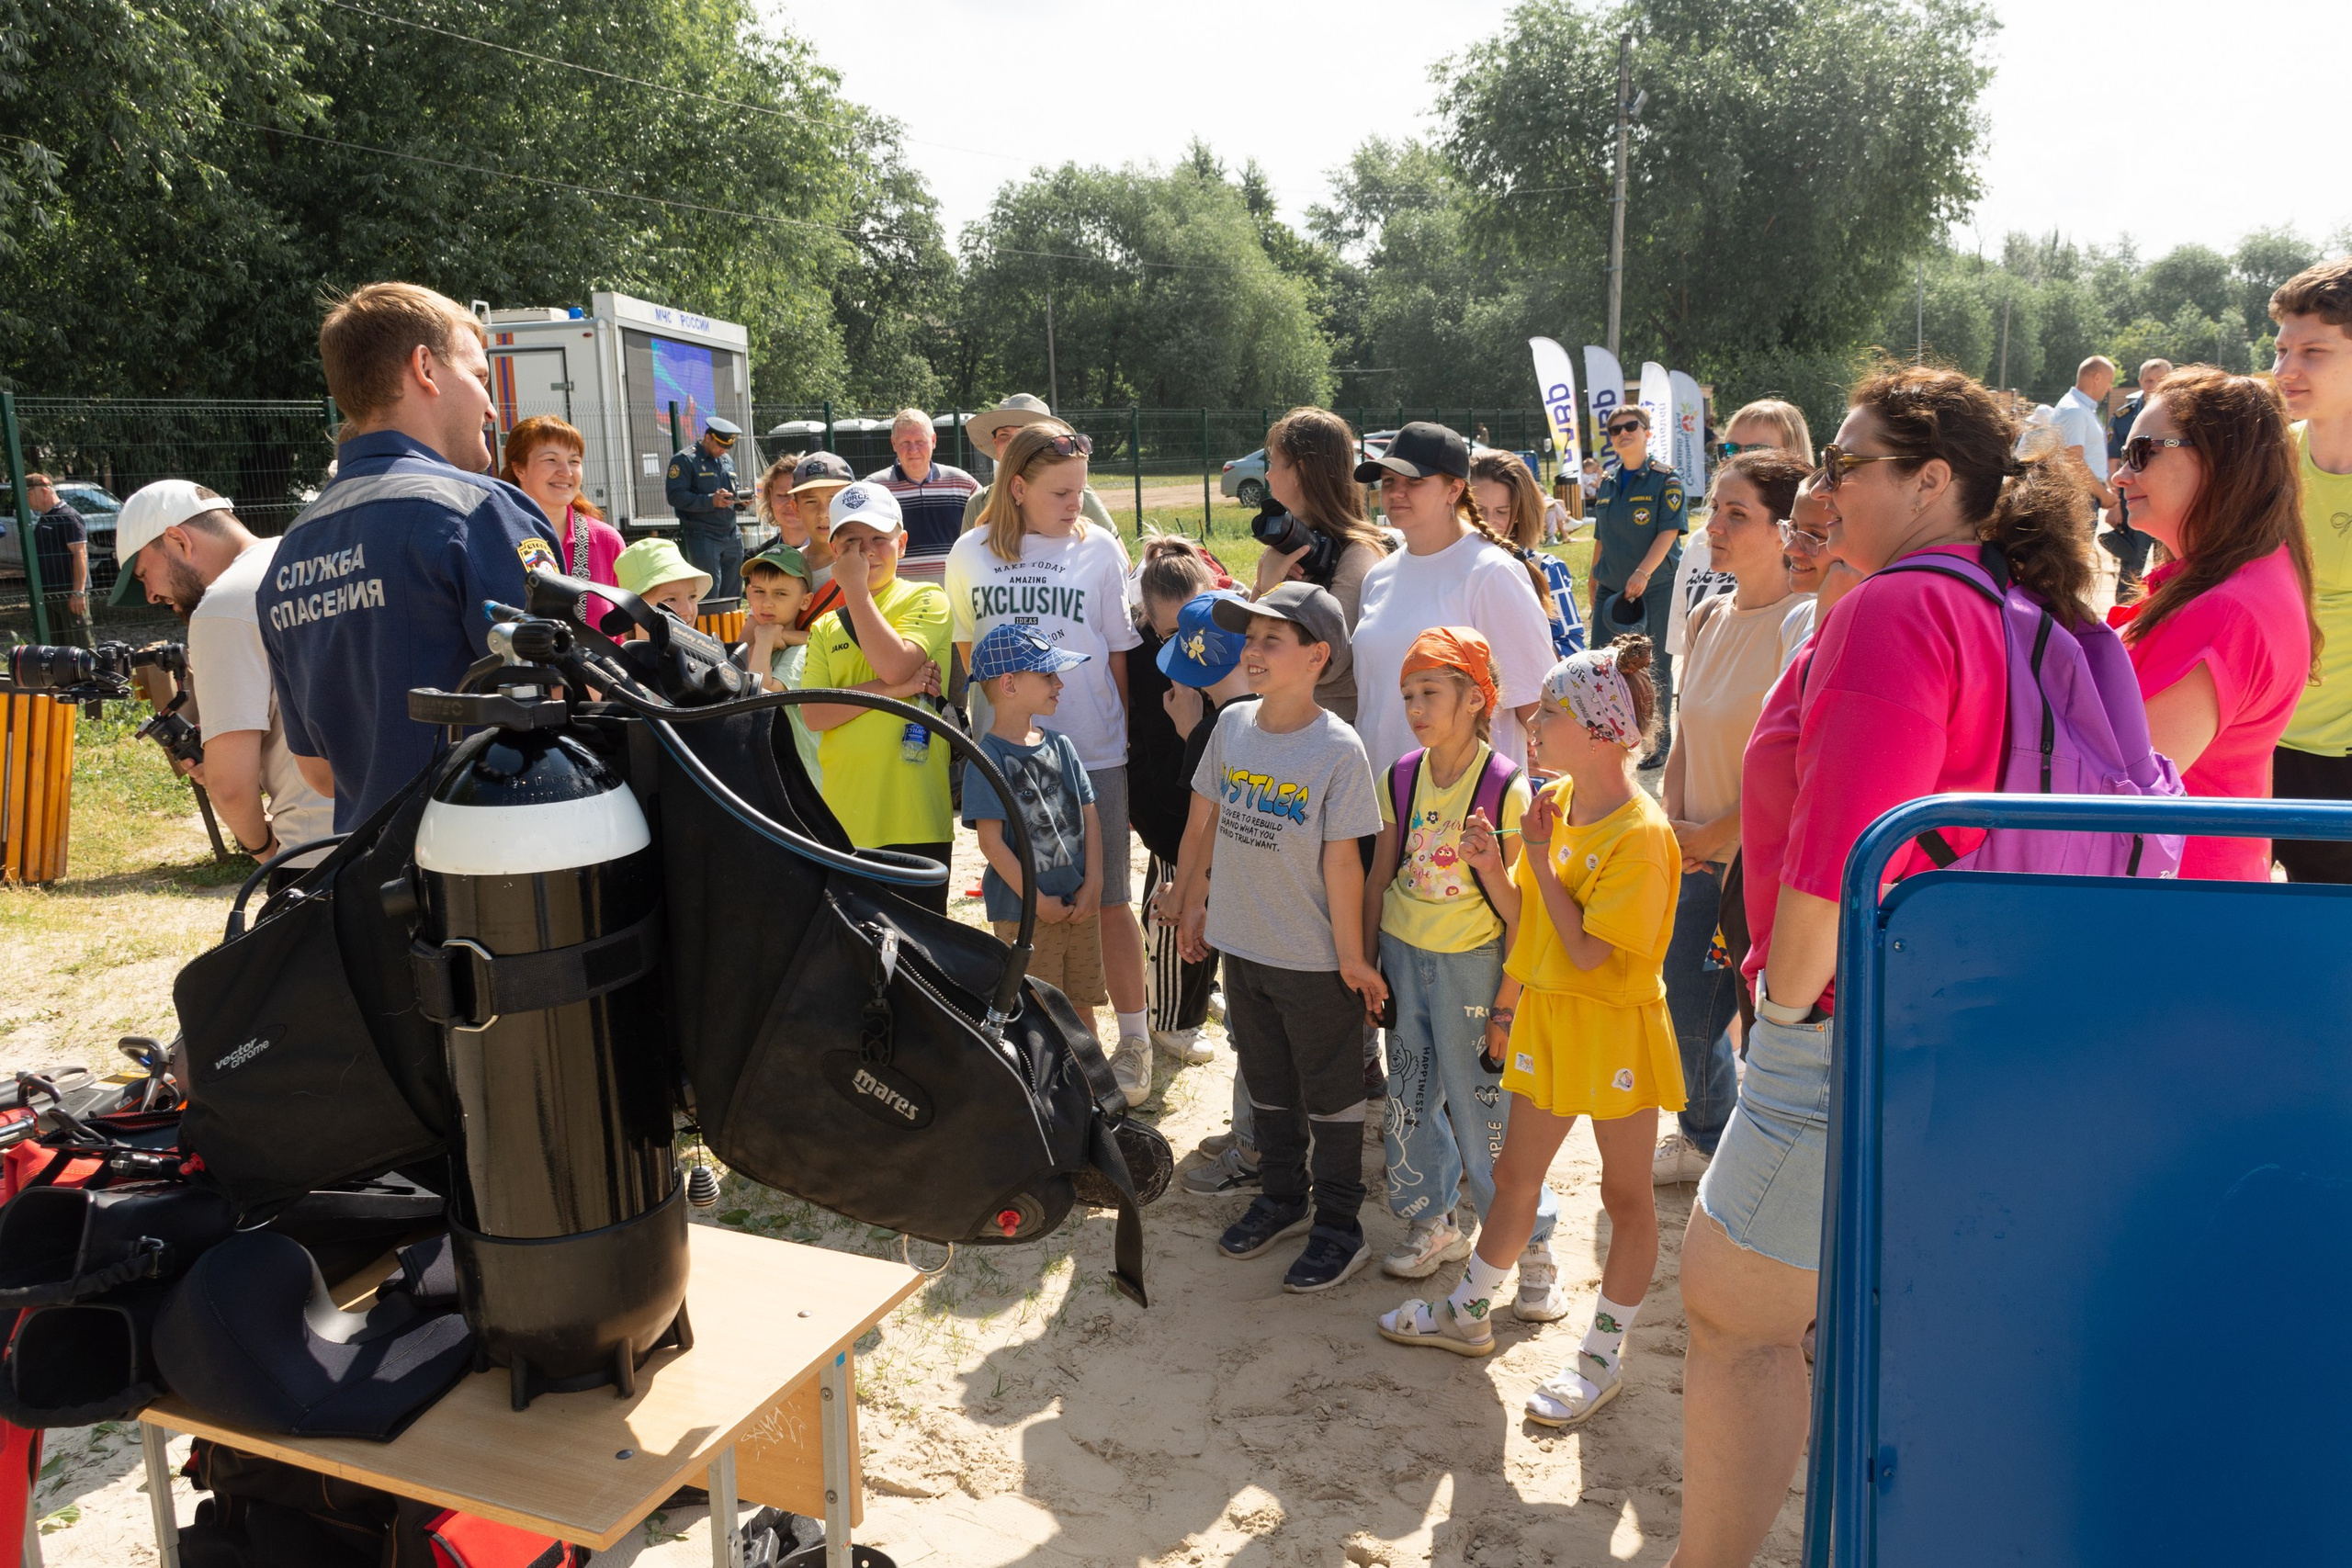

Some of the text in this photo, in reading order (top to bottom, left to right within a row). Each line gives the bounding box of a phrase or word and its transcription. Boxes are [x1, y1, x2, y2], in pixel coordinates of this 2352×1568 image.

[655, 308, 710, 332] МЧС РОССИИ
[842, 493, 870, 504] FORCE
[277, 543, 366, 592] СЛУЖБА
[994, 561, 1066, 574] MAKE TODAY
[1009, 576, 1047, 584] AMAZING
[270, 579, 386, 632] СПАСЕНИЯ
[971, 585, 1085, 624] EXCLUSIVE
[673, 626, 696, 642] Buddy
[696, 638, 720, 654] Phone
[831, 642, 850, 653] JAKO
[1566, 661, 1587, 683] CUTE
[1226, 808, 1240, 821] OVER
[1242, 814, 1250, 823] TO
[1251, 817, 1283, 831] REBUILD
[1235, 832, 1255, 846] TRULY
[1255, 839, 1280, 852] WANT.
[1239, 823, 1260, 837] WHAT
[1260, 830, 1275, 840] YOU
[215, 1038, 257, 1070] vector
[231, 1040, 269, 1068] chrome
[1415, 1046, 1430, 1113] HAPPINESS
[853, 1068, 919, 1120] mares
[1475, 1092, 1499, 1102] CUTE
